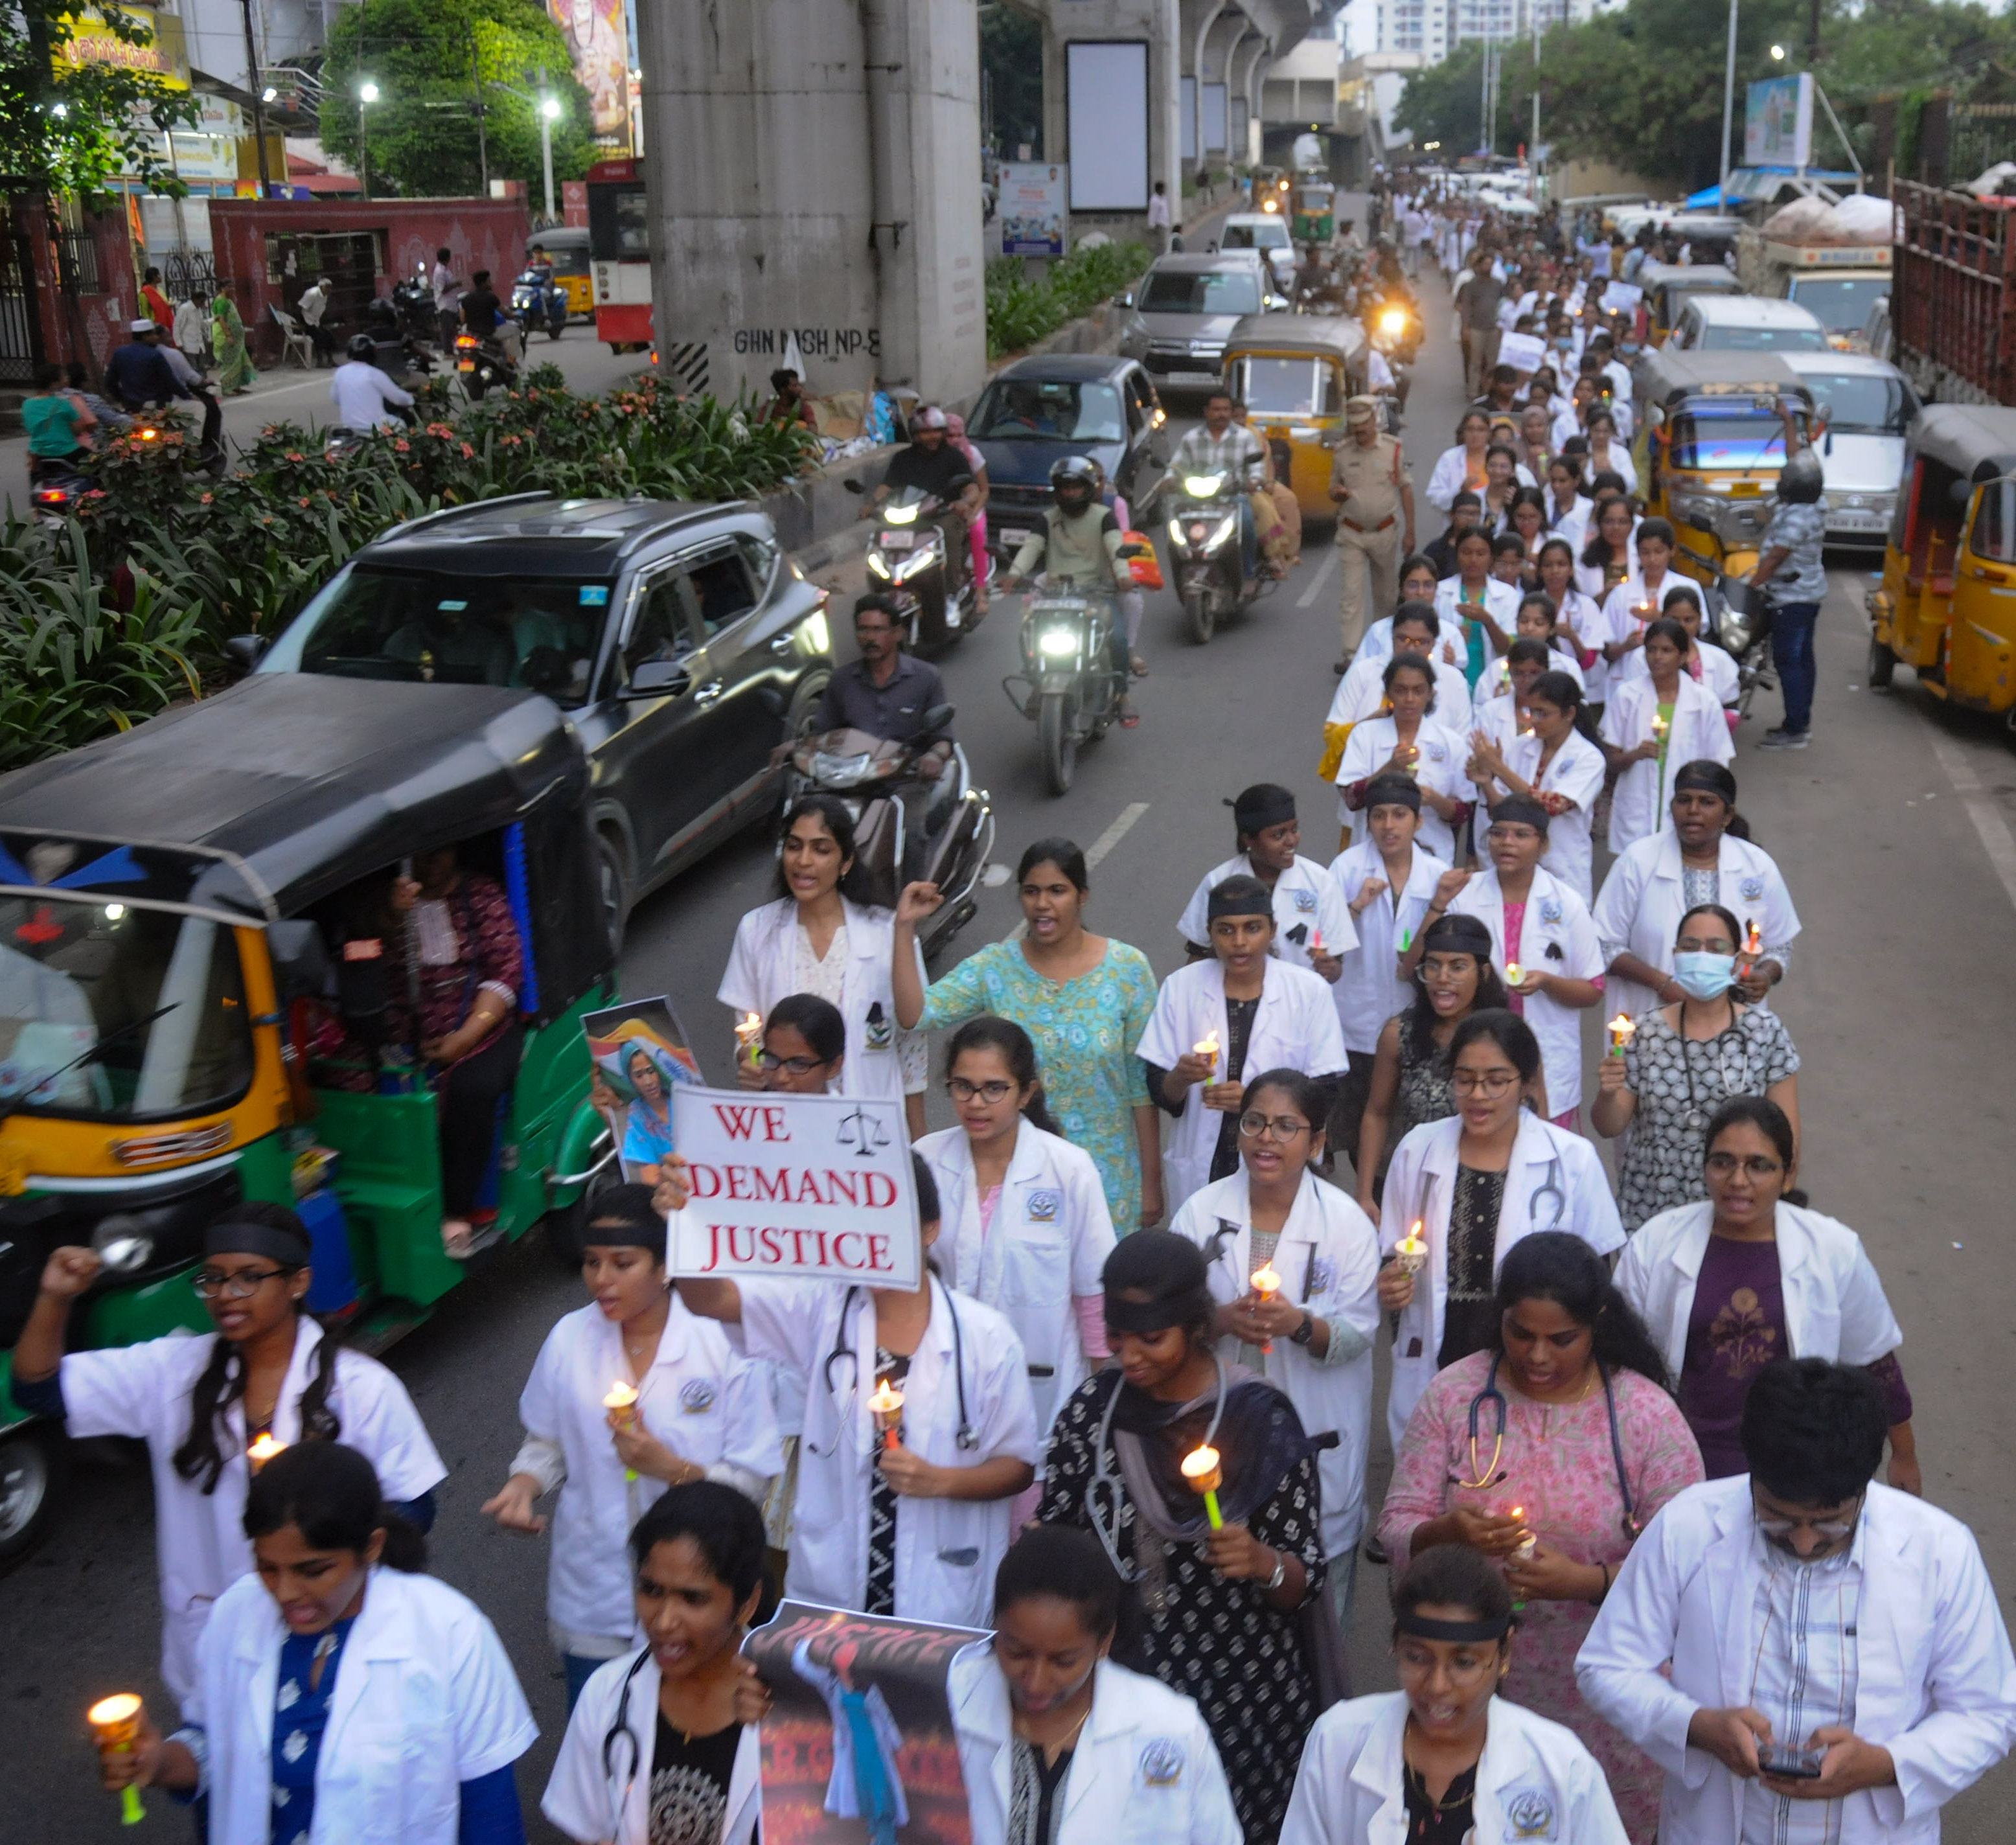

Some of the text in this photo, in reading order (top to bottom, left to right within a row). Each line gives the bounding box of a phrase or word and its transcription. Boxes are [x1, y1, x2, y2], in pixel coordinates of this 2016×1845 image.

[735, 329, 774, 354] GHN
[711, 1104, 792, 1143] WE
[687, 1163, 899, 1209] DEMAND
[700, 1224, 895, 1272] JUSTICE
